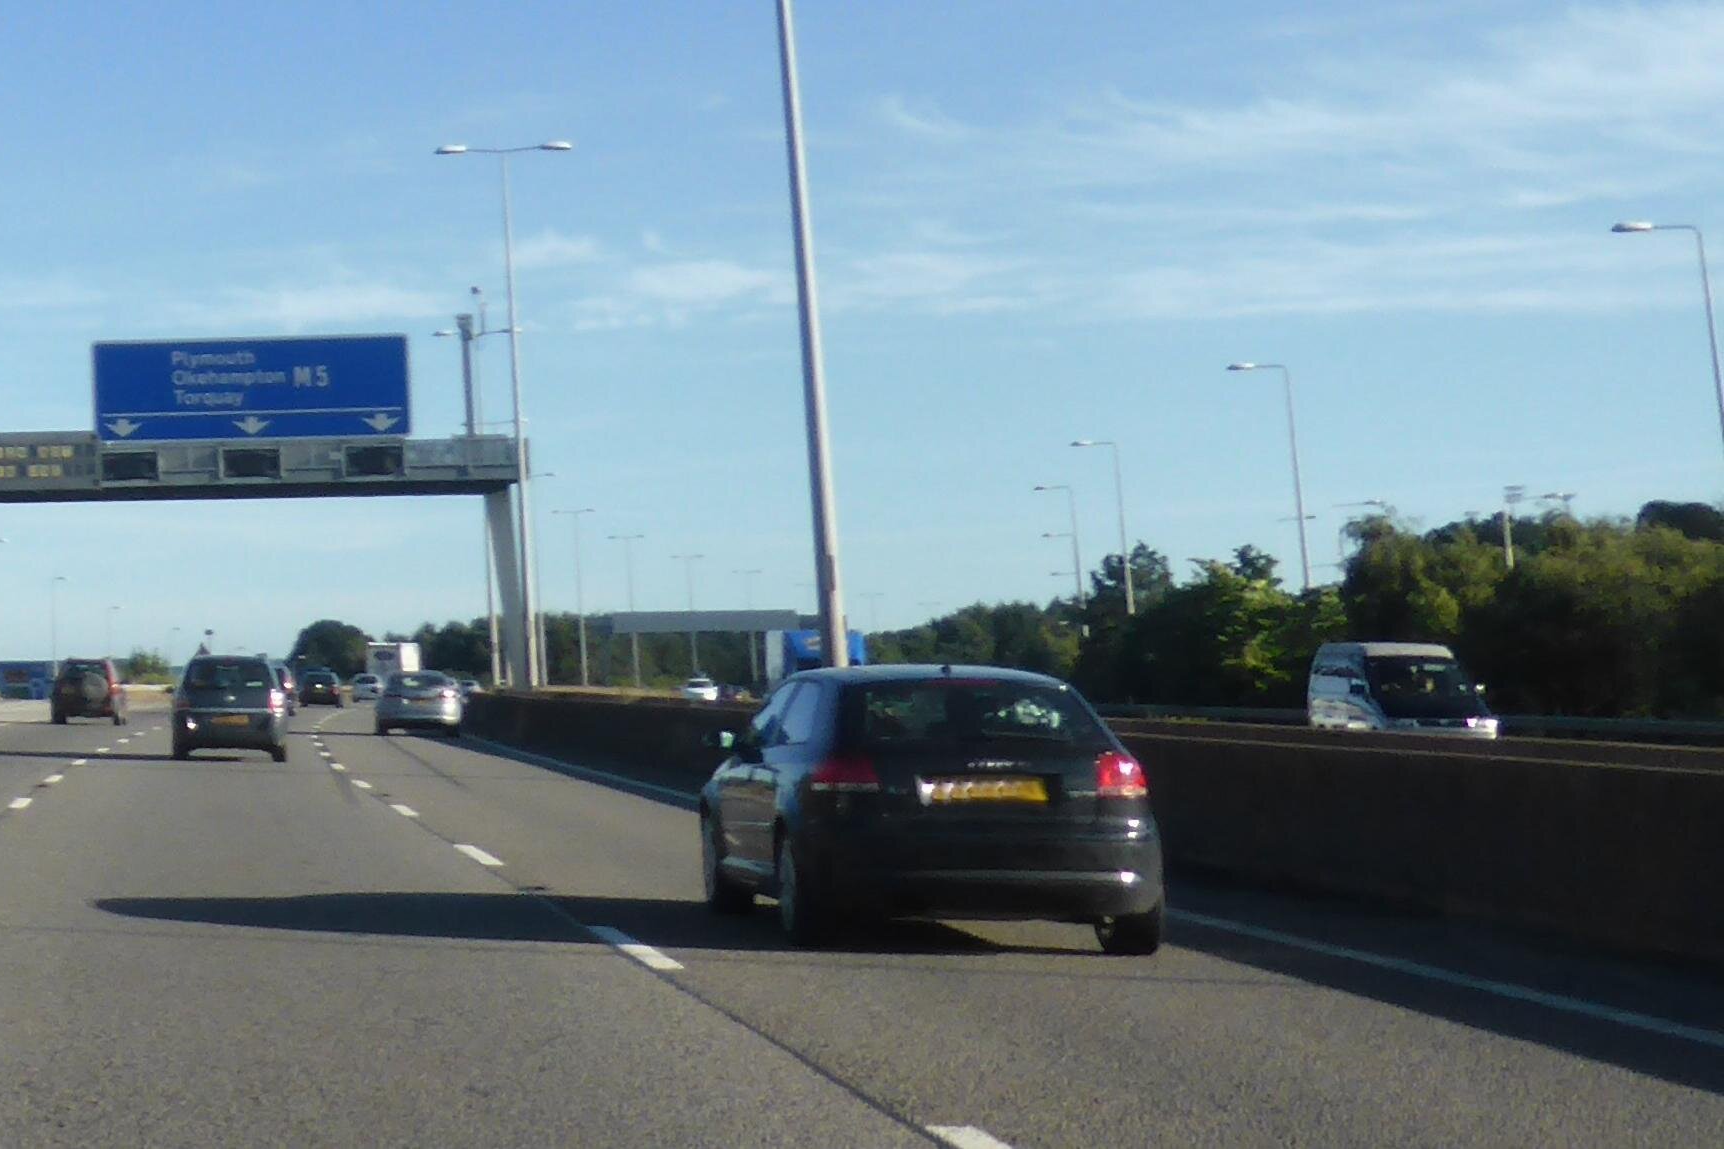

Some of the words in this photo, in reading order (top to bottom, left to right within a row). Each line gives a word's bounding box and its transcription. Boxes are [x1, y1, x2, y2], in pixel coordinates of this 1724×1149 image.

[172, 350, 255, 368] Plymouth
[172, 369, 286, 387] Okehampton
[175, 389, 244, 406] Torquay
